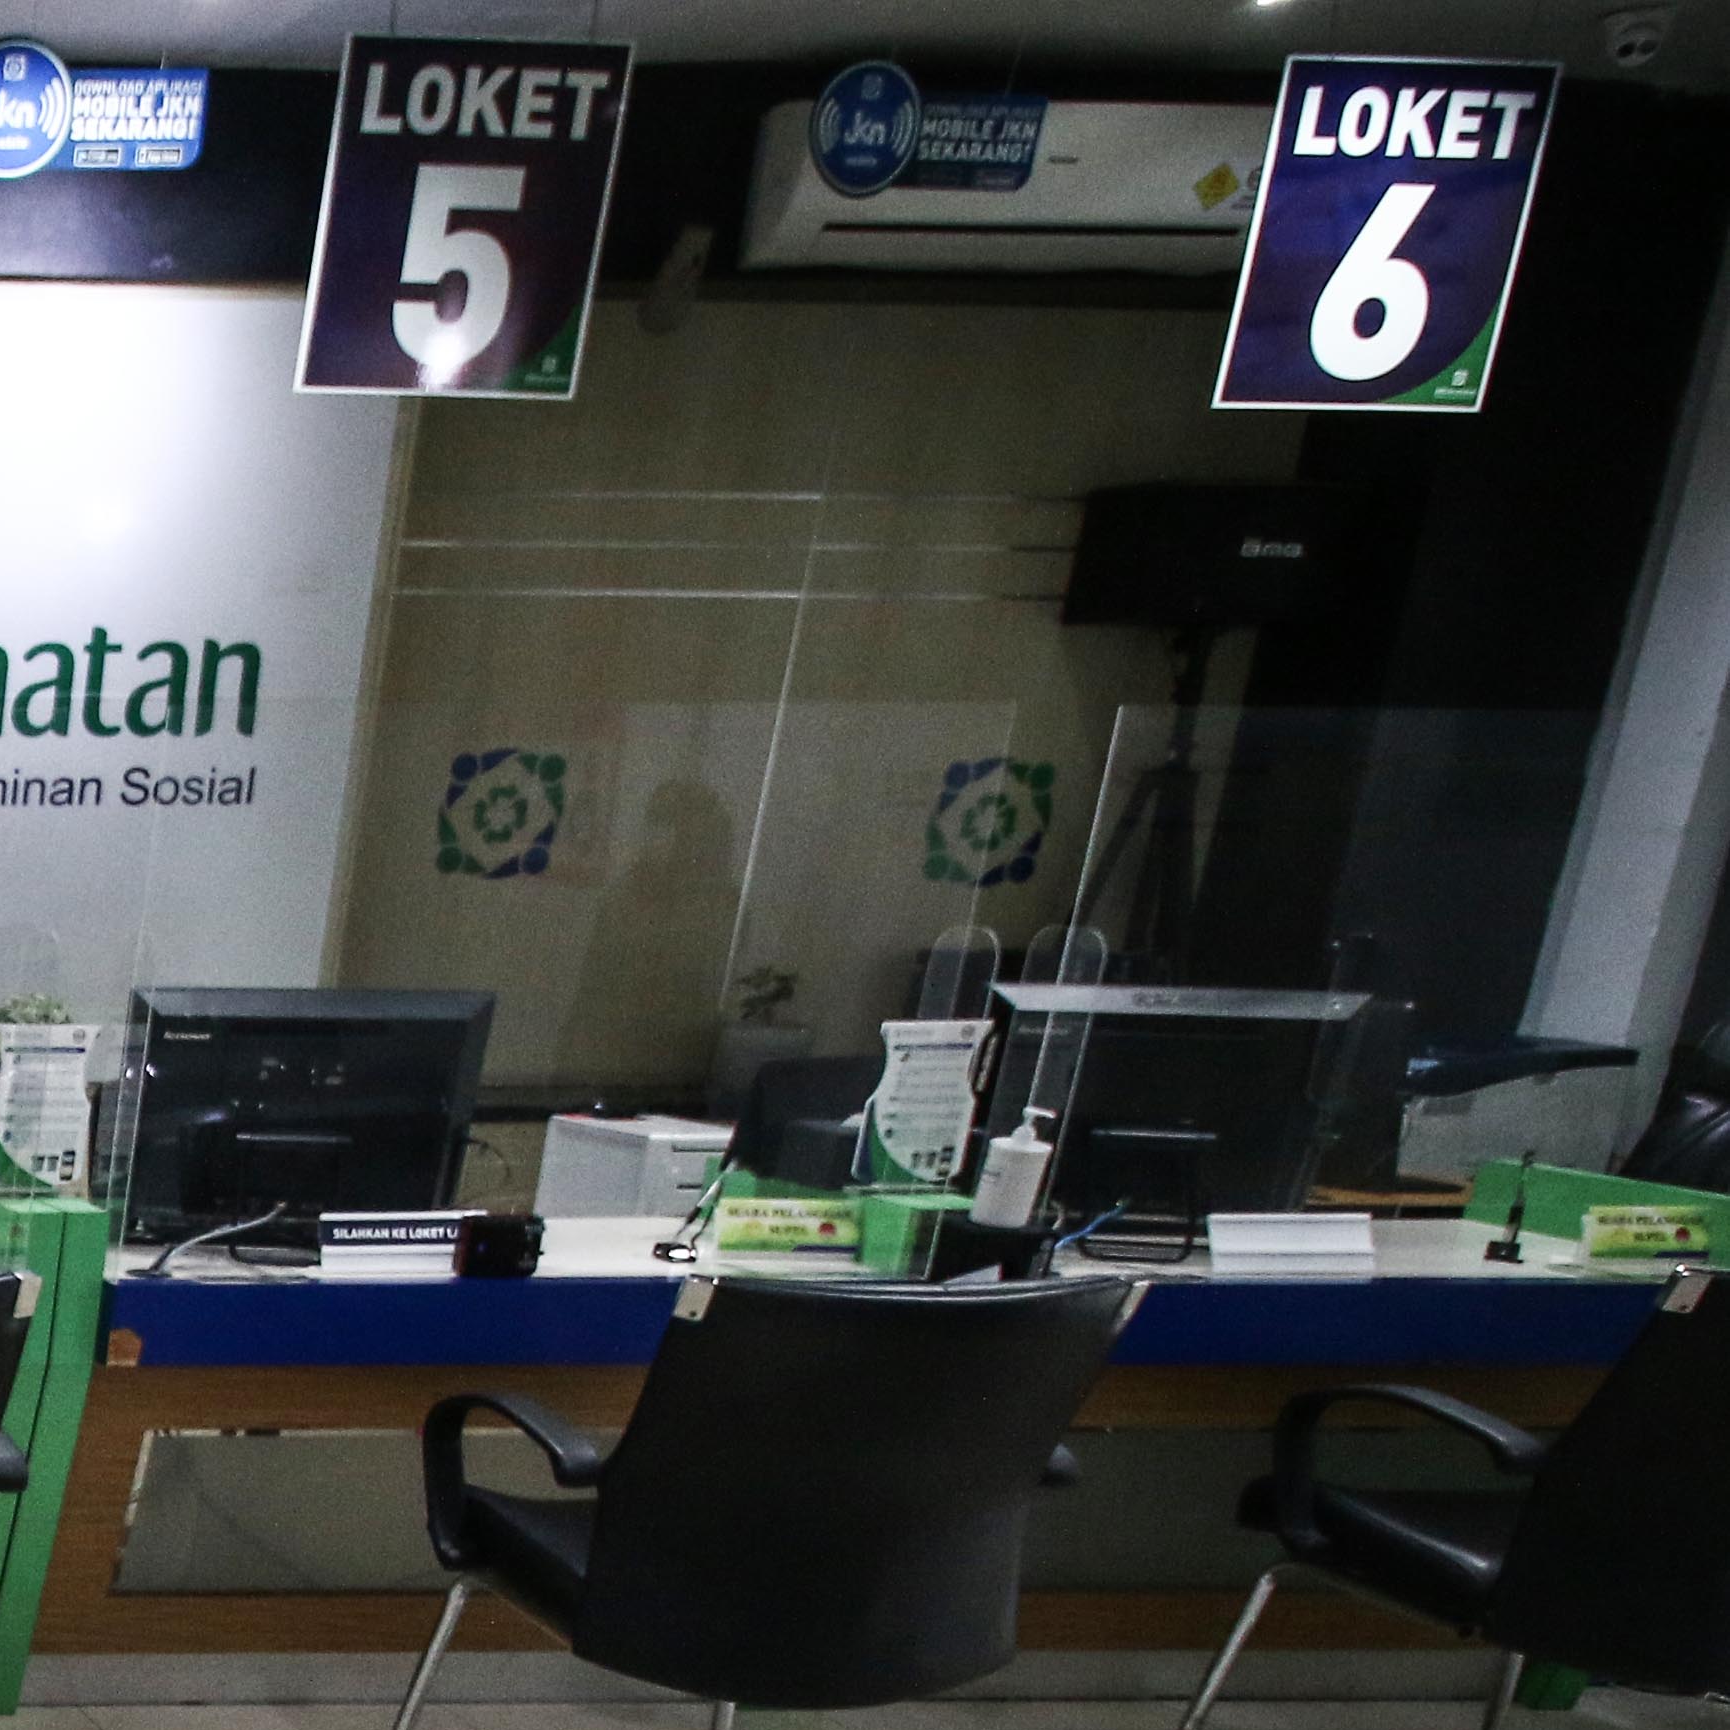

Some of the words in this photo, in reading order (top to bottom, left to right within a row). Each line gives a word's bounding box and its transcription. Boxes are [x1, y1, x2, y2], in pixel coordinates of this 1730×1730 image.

[74, 80, 145, 96] DOWNLOAD
[146, 79, 202, 96] APLIKASI
[359, 64, 609, 140] LOKET
[72, 95, 153, 118] MOBILE
[156, 95, 201, 119] JKN
[1292, 84, 1535, 160] LOKET
[70, 116, 198, 141] SEKARANG!
[922, 118, 995, 139] MOBILE
[998, 118, 1037, 139] JKN
[391, 164, 525, 378] 5
[1309, 183, 1436, 382] 6
[119, 766, 258, 807] Sosial
[333, 1227, 390, 1240] SILAHKAN
[391, 1227, 407, 1239] KE
[409, 1227, 445, 1239] LOKET
